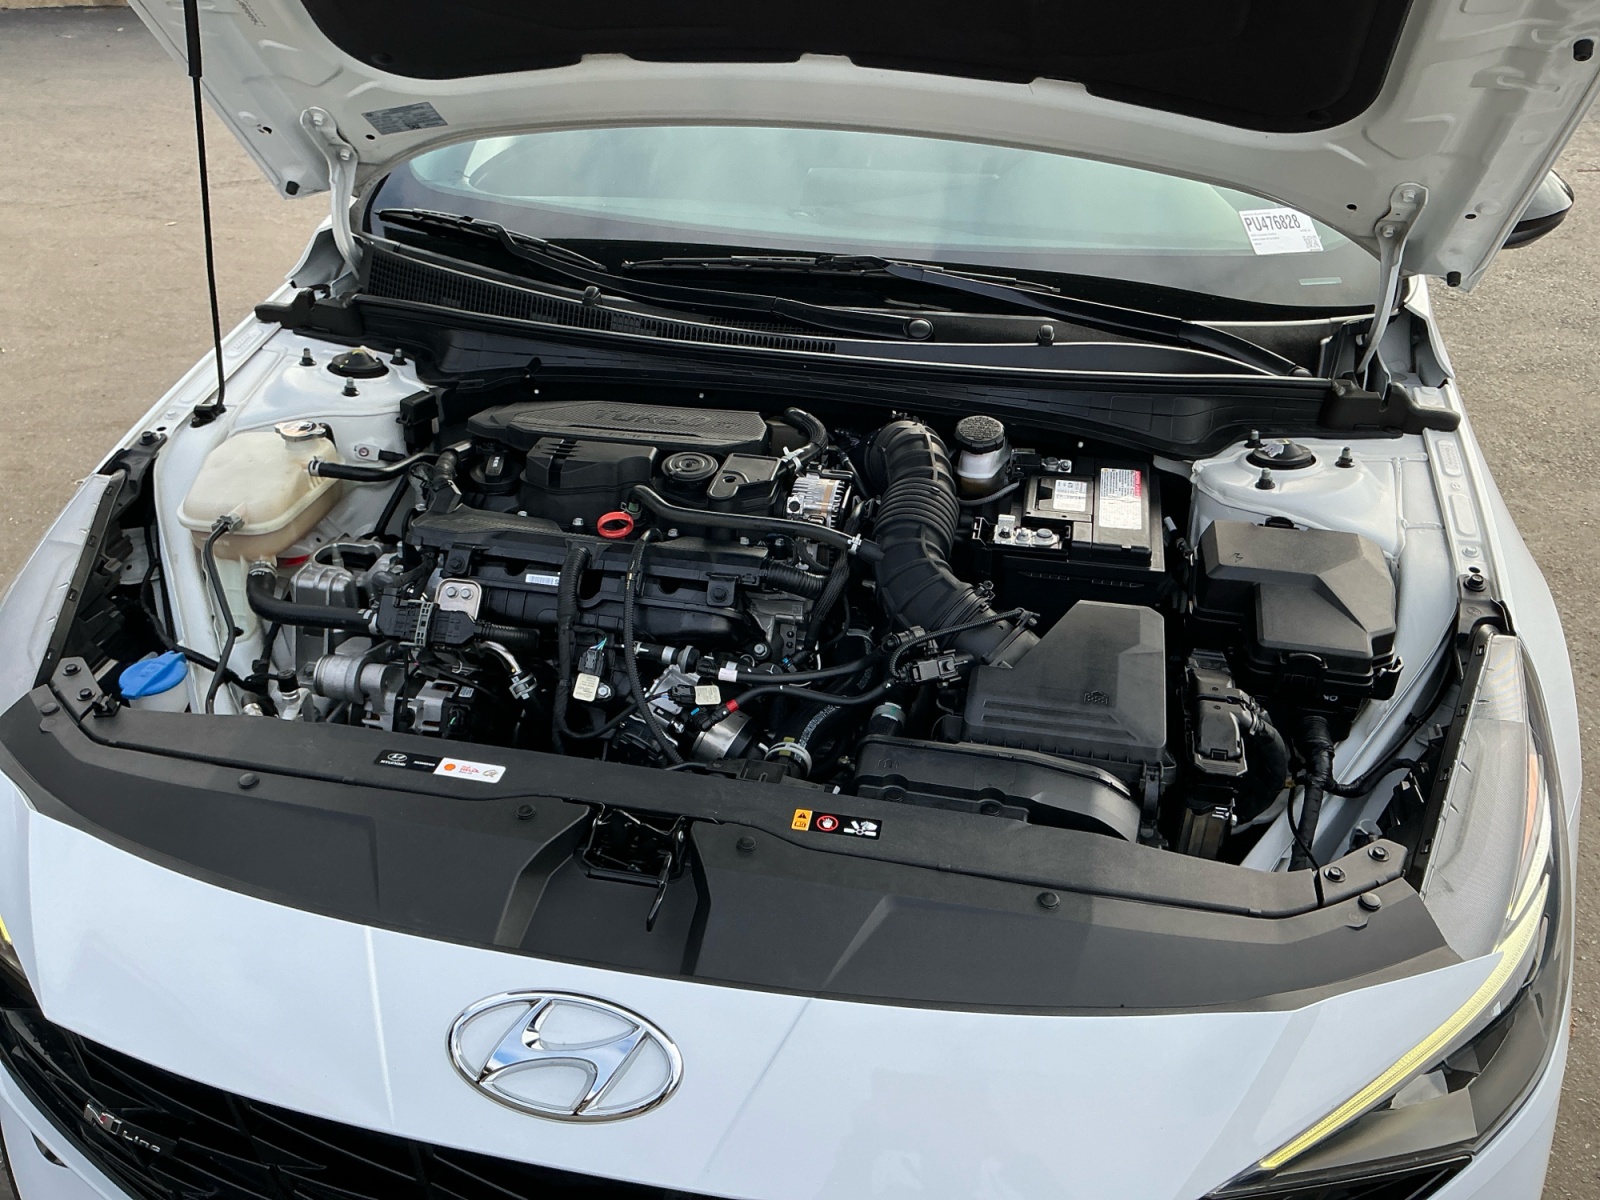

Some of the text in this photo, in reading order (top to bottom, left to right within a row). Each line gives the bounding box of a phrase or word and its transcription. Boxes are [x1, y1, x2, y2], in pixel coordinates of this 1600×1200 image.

[1243, 214, 1301, 232] PU476828
[595, 409, 711, 427] TURBO
[122, 1129, 161, 1153] Line
